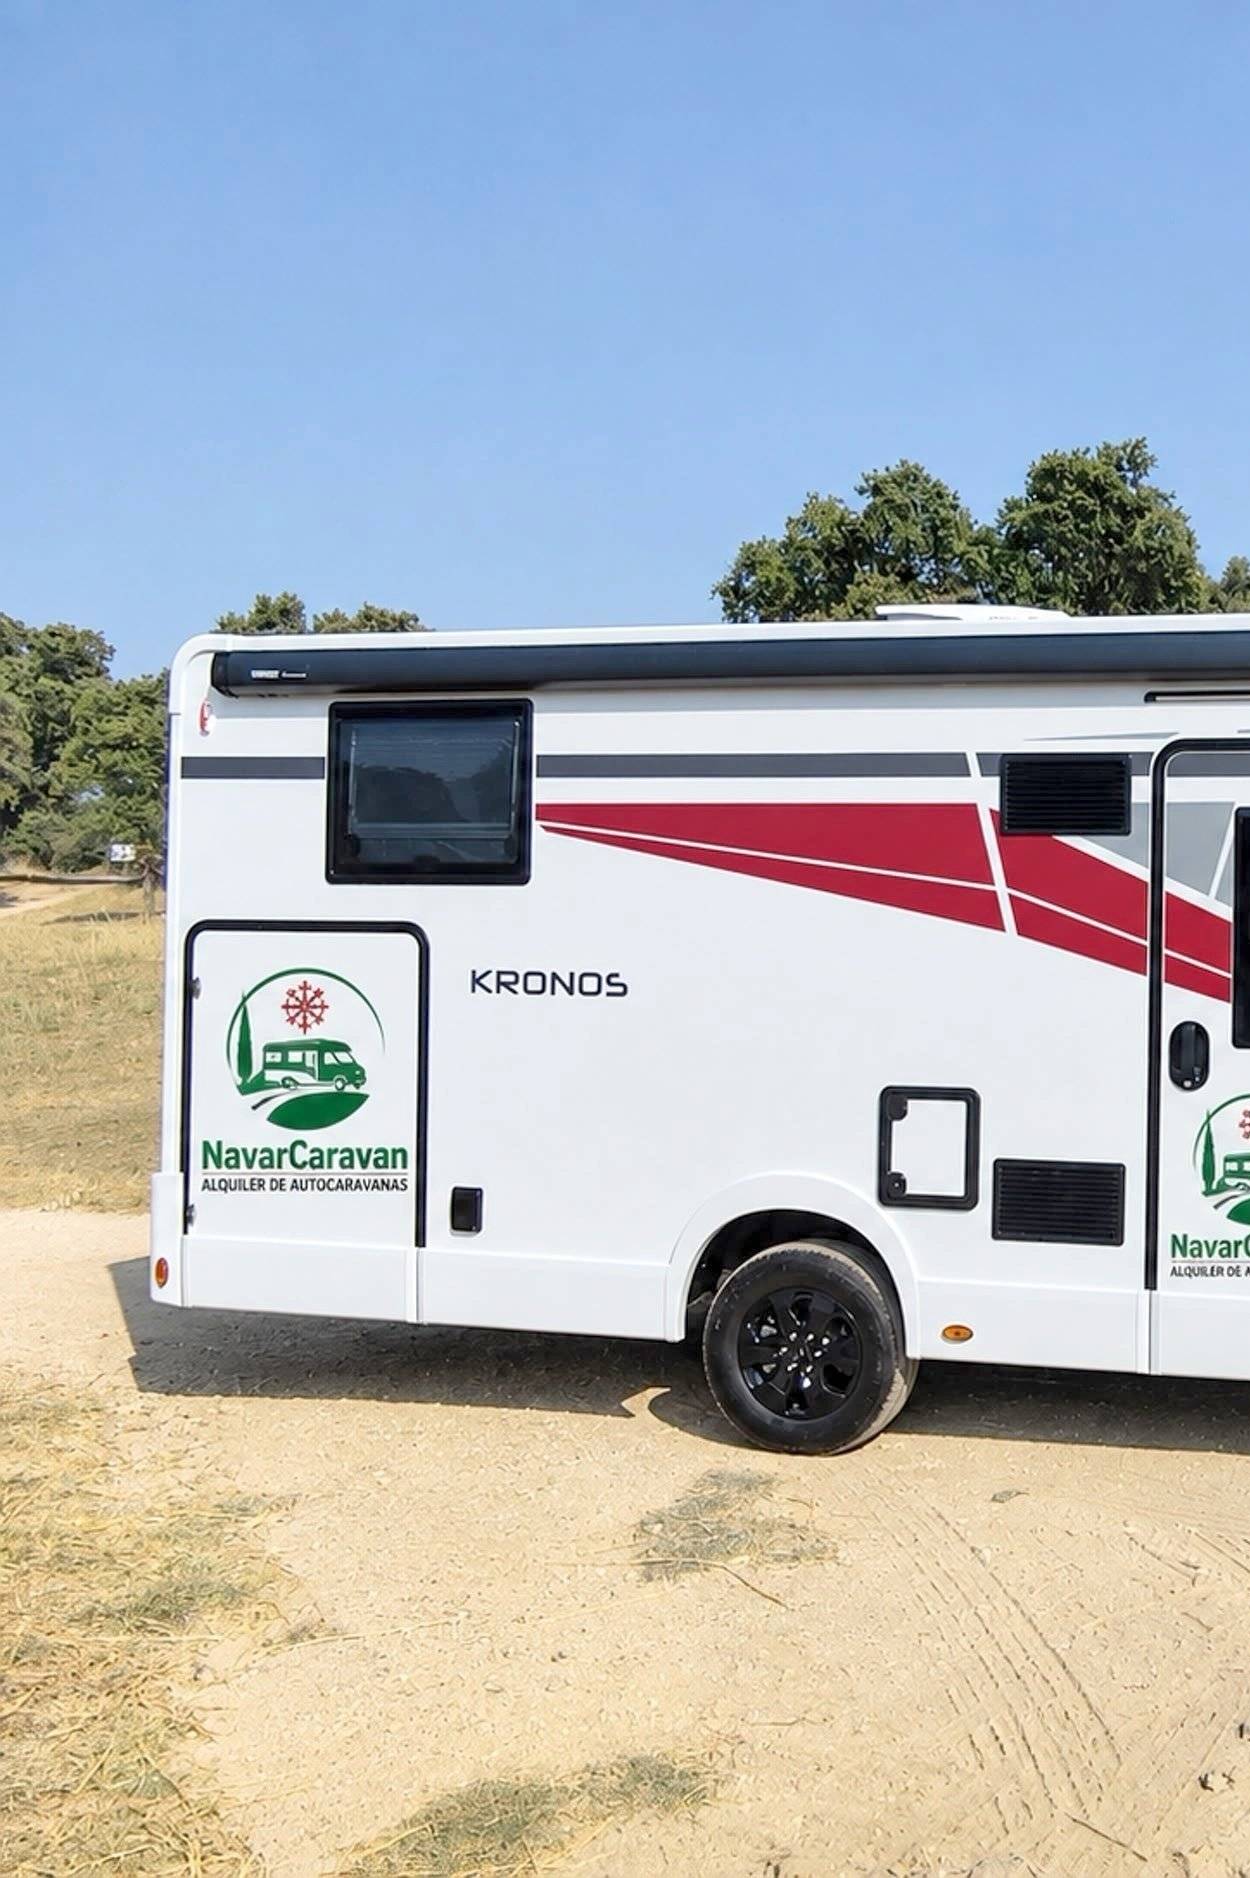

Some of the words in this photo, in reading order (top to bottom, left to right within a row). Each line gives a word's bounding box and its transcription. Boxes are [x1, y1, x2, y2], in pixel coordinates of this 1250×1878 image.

[471, 969, 628, 997] KRONOS
[202, 1139, 408, 1169] NavarCaravan
[201, 1178, 265, 1193] ALQUILER
[269, 1178, 286, 1191] DE
[290, 1178, 408, 1191] AUTOCARAVANAS
[1170, 1266, 1224, 1279] ALQUILER
[1227, 1266, 1242, 1278] DE
